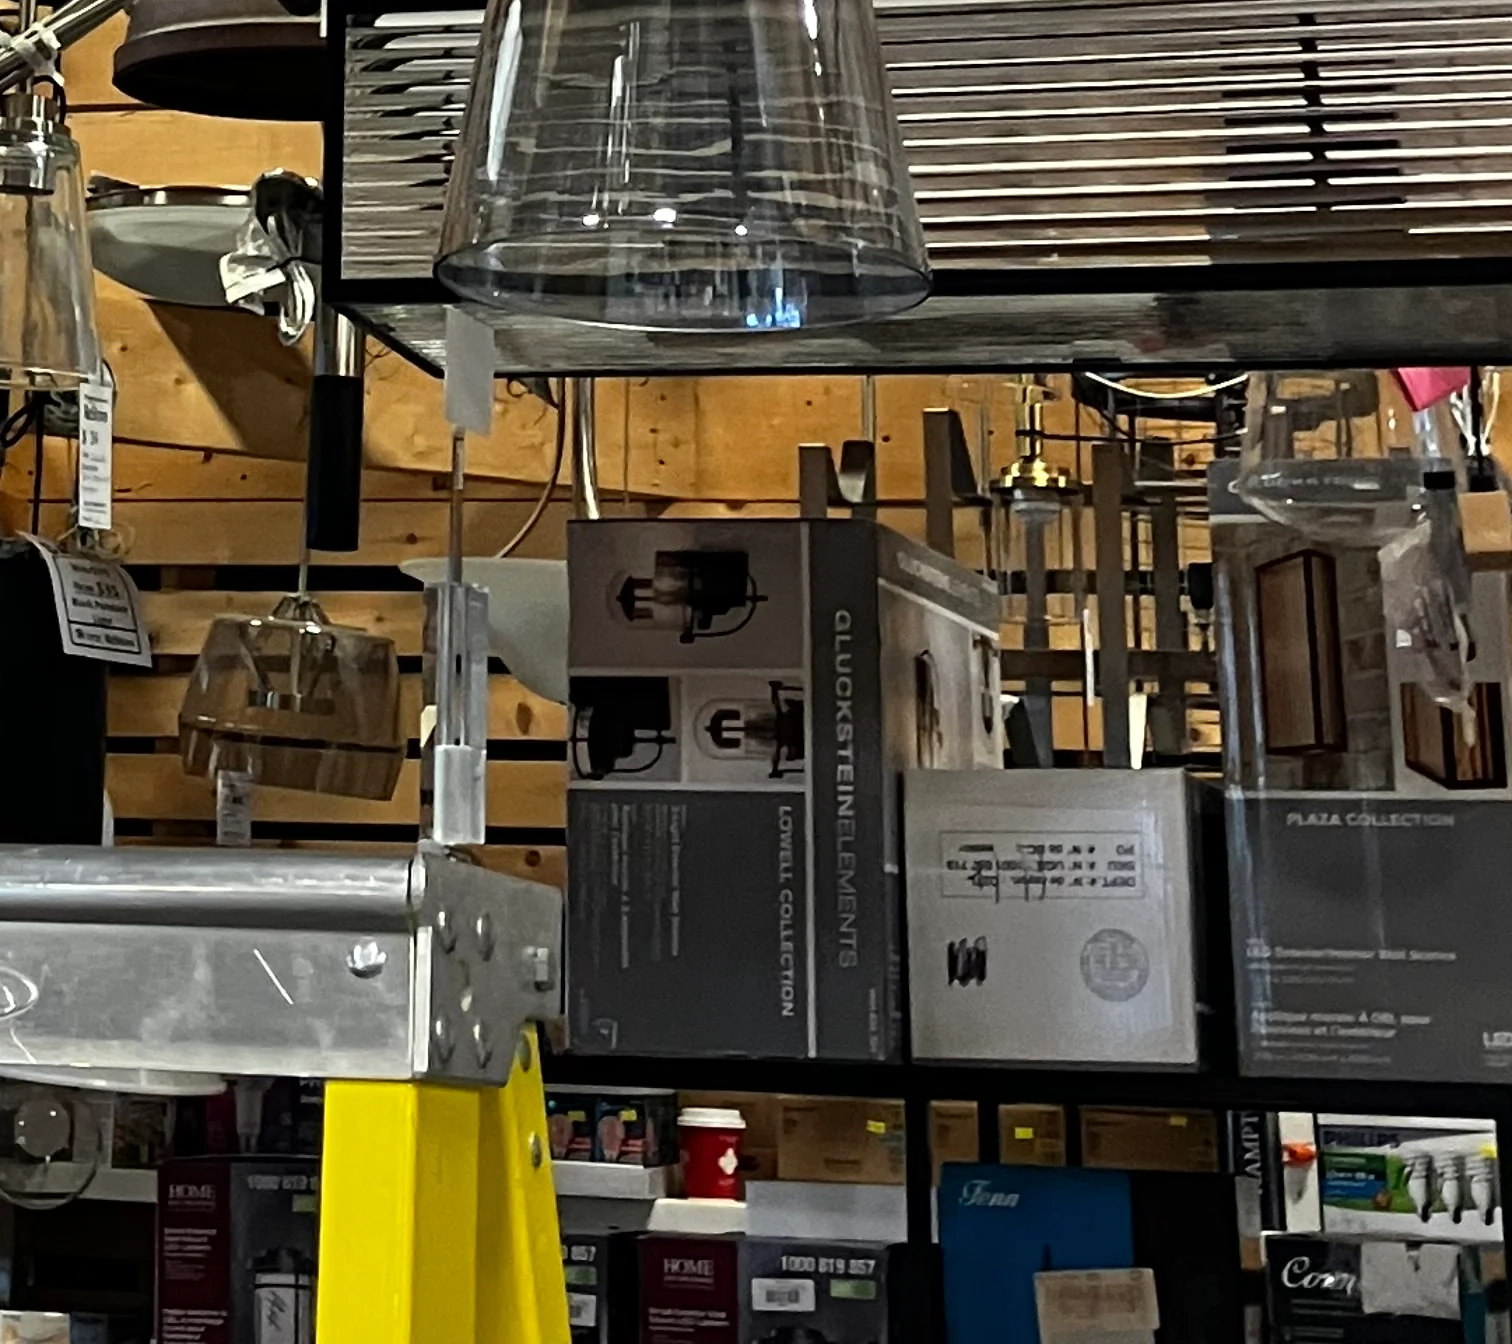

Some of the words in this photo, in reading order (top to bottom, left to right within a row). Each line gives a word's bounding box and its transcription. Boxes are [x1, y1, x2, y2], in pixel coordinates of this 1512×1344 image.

[1287, 812, 1342, 827] PLAZA
[1345, 813, 1456, 827] COLLECTION
[777, 805, 794, 883] LOWELL
[778, 889, 795, 1017] COLLECTION
[168, 1184, 217, 1199] HOME
[663, 1258, 715, 1276] HOME
[780, 1255, 817, 1272] 1000
